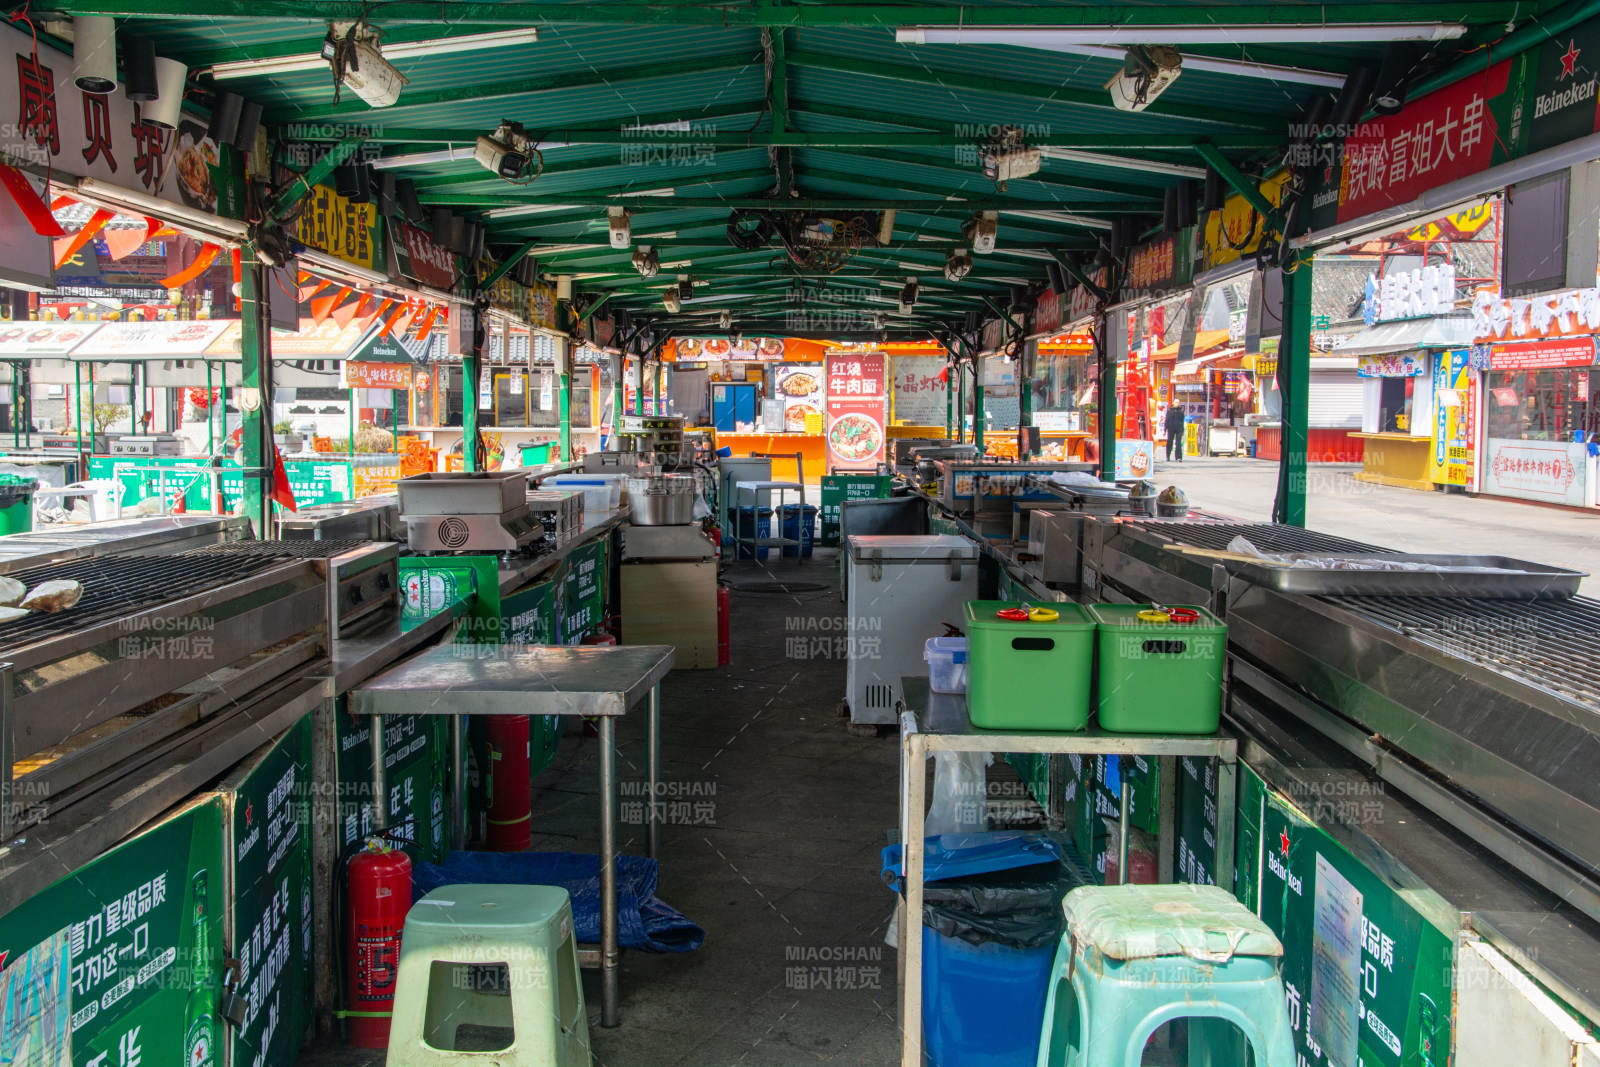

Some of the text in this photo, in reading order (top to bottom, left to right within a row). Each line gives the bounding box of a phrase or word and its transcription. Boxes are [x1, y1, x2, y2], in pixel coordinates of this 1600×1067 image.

[1534, 79, 1596, 119] Heineken
[1348, 93, 1485, 201] 铁岭富姐大串
[1313, 191, 1338, 210] Heineken
[373, 346, 397, 356] Heineken
[831, 362, 861, 376] 红烧
[830, 378, 877, 395] 牛肉面
[342, 728, 370, 752] Heineken
[238, 826, 260, 863] Heineken
[1268, 850, 1303, 896] Heineken
[71, 871, 168, 958] 喜力星级品质
[71, 920, 149, 996] 只为这一口
